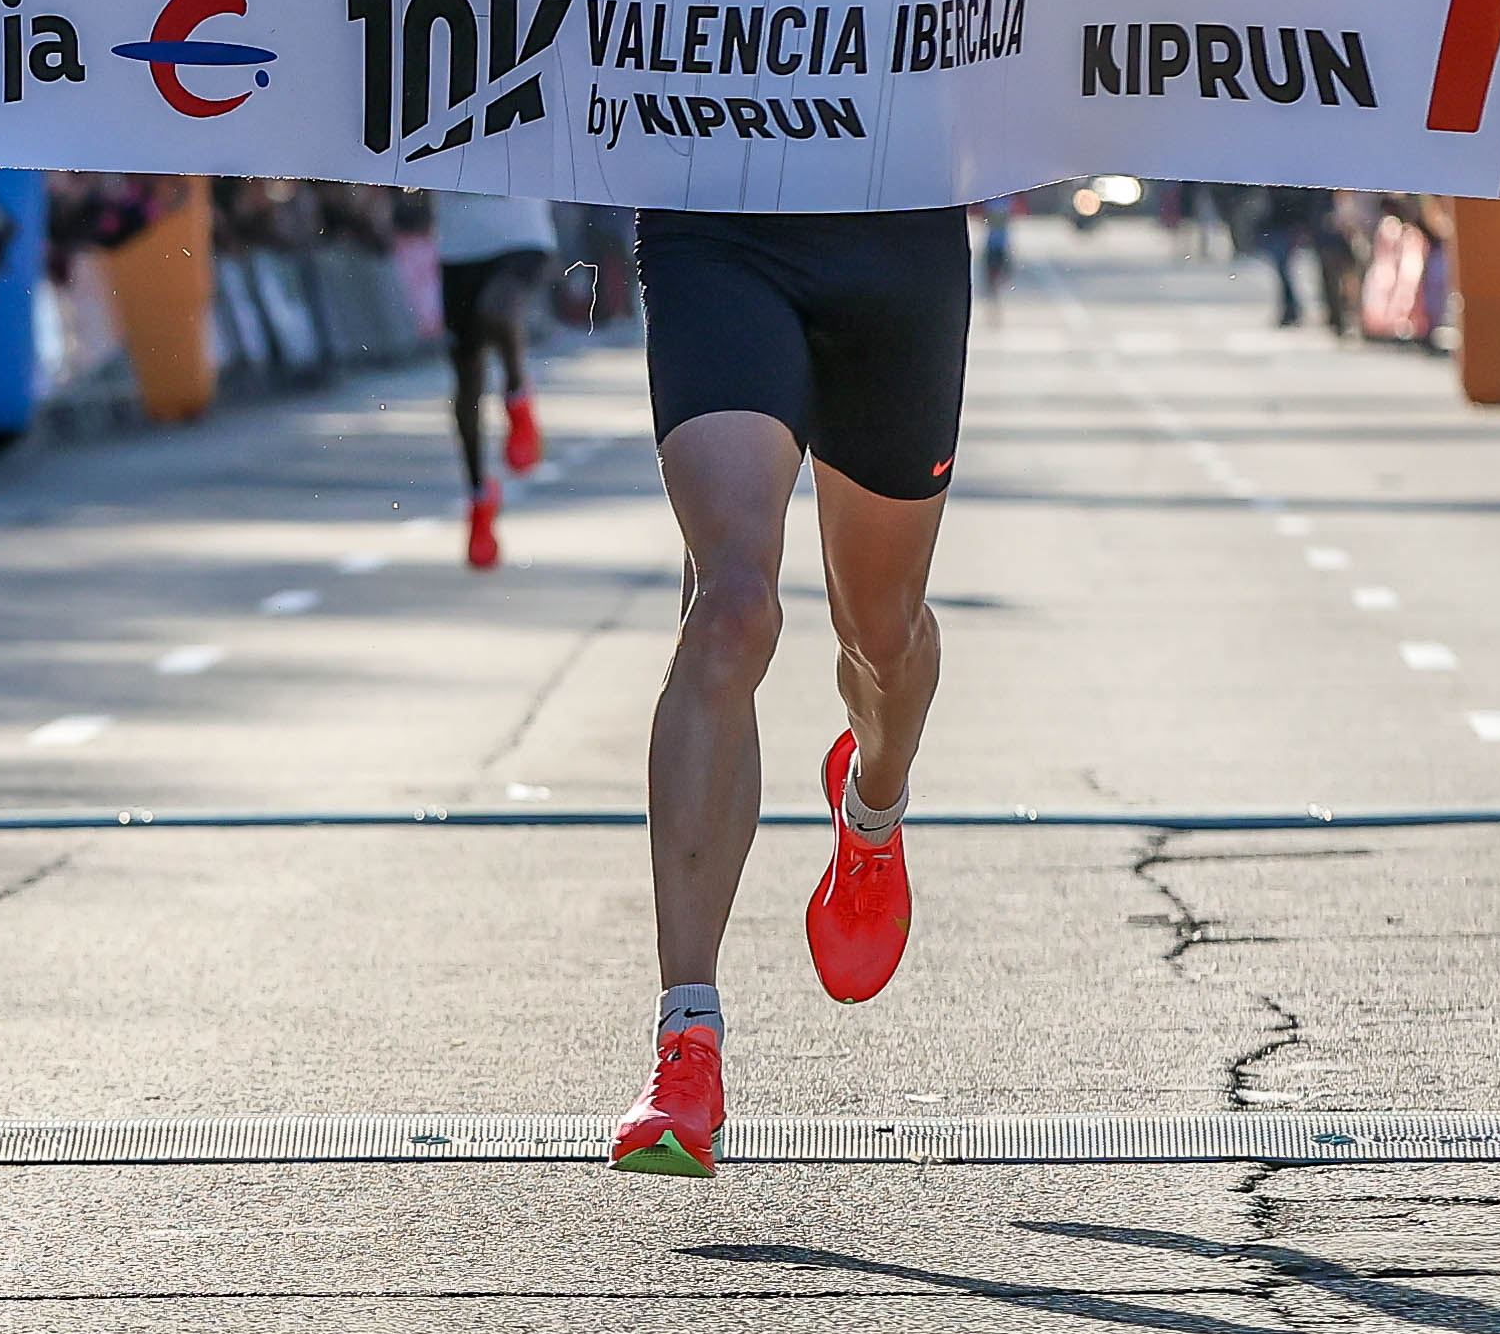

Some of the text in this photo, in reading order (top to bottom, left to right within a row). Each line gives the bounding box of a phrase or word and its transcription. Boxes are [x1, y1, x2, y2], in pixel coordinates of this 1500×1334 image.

[1081, 22, 1380, 109] KIPRUN
[586, 82, 869, 151] by KIPRUN
